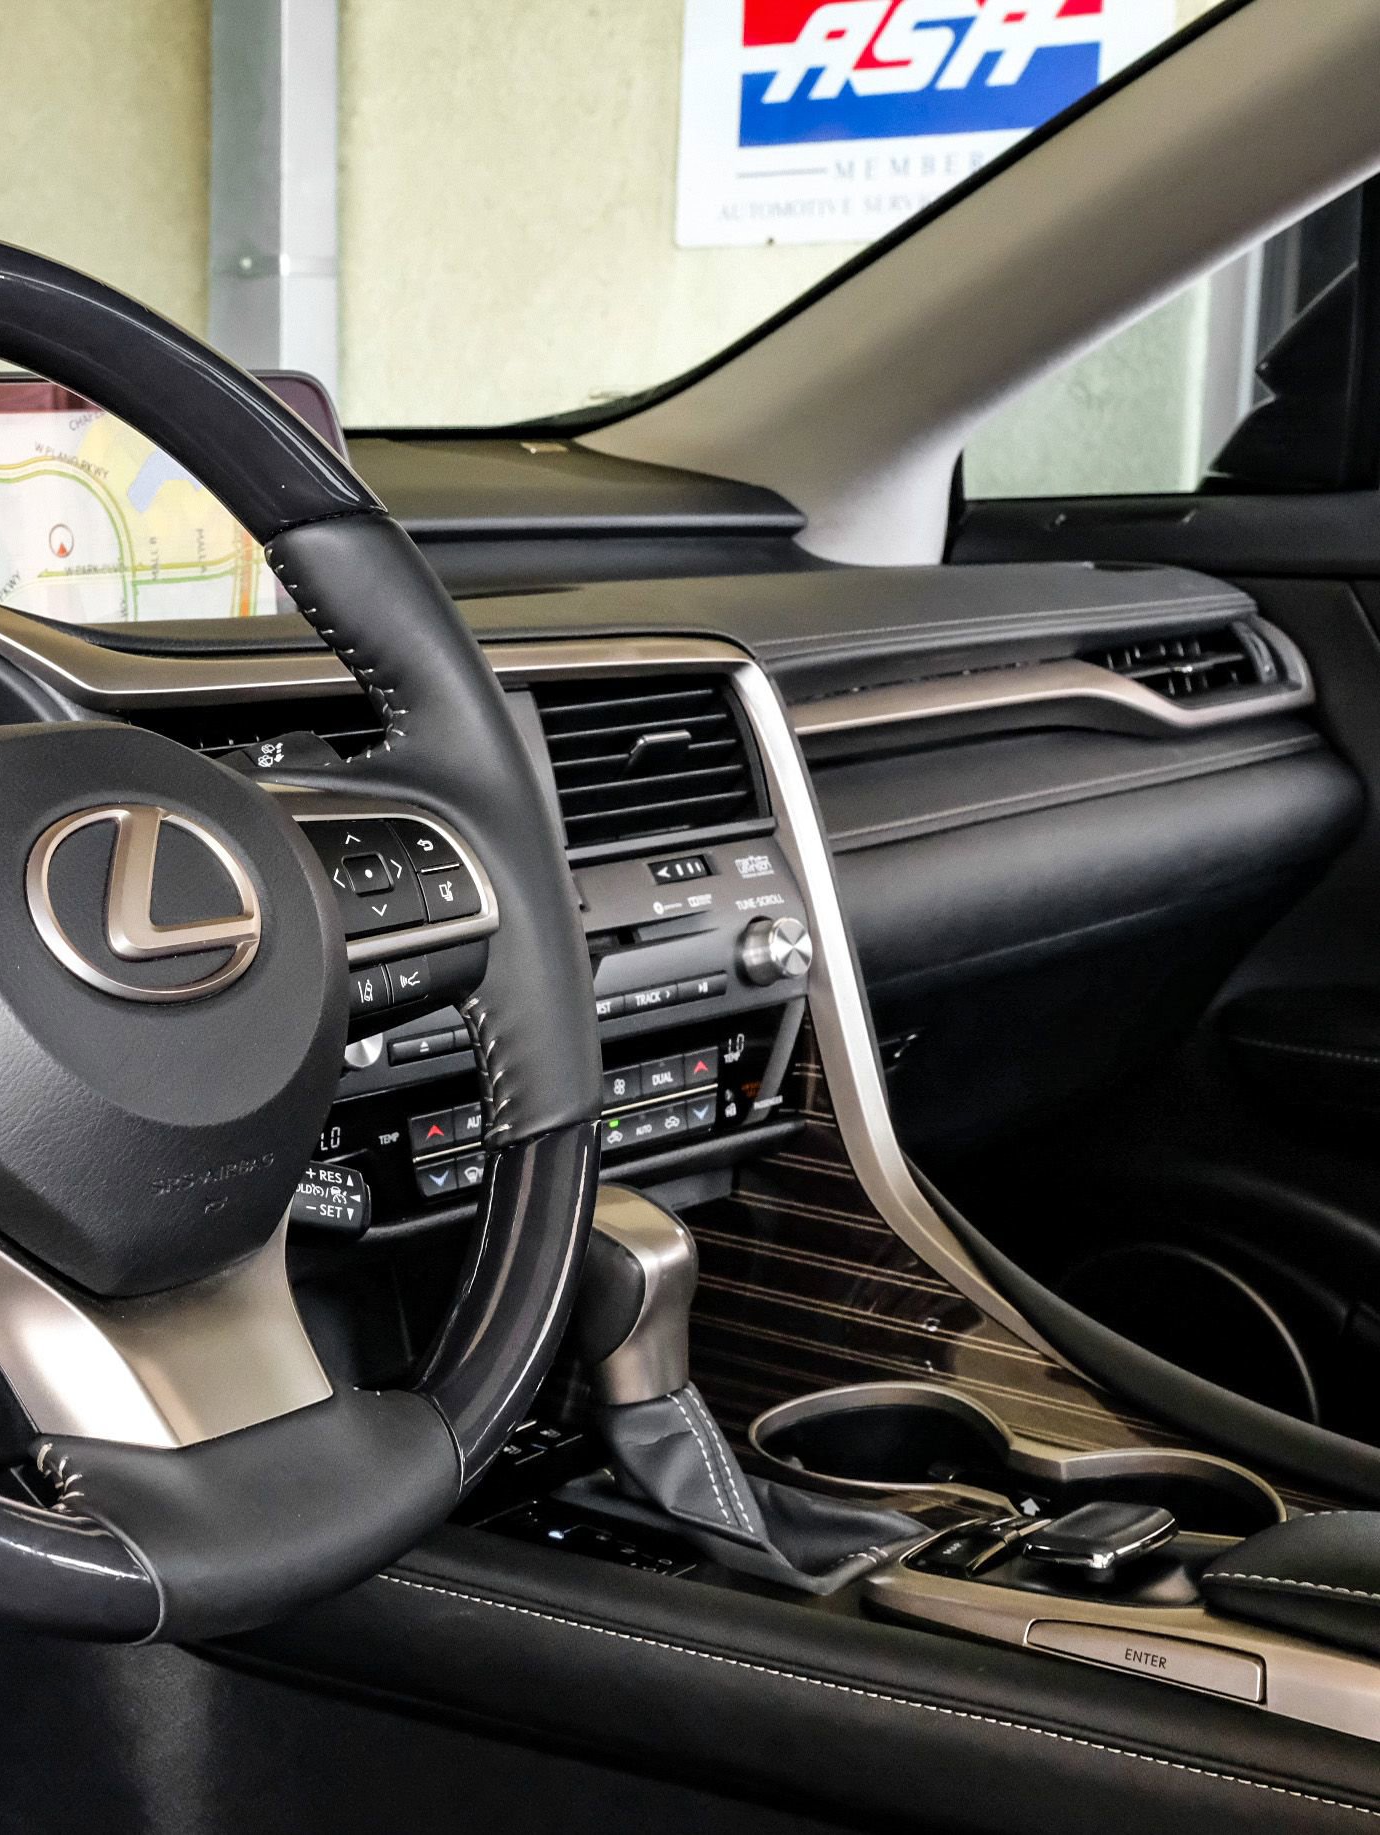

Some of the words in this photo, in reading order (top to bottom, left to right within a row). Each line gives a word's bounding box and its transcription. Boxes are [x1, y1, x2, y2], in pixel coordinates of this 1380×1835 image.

[760, 0, 1060, 104] ASA
[834, 152, 985, 179] MEMBER
[634, 990, 661, 1007] TRACK
[651, 1071, 674, 1086] DUAL
[636, 1124, 652, 1135] AUTO
[378, 1132, 400, 1146] TEMP
[319, 1169, 343, 1184] RES
[319, 1203, 343, 1219] SET
[1124, 1648, 1168, 1670] ENTER
